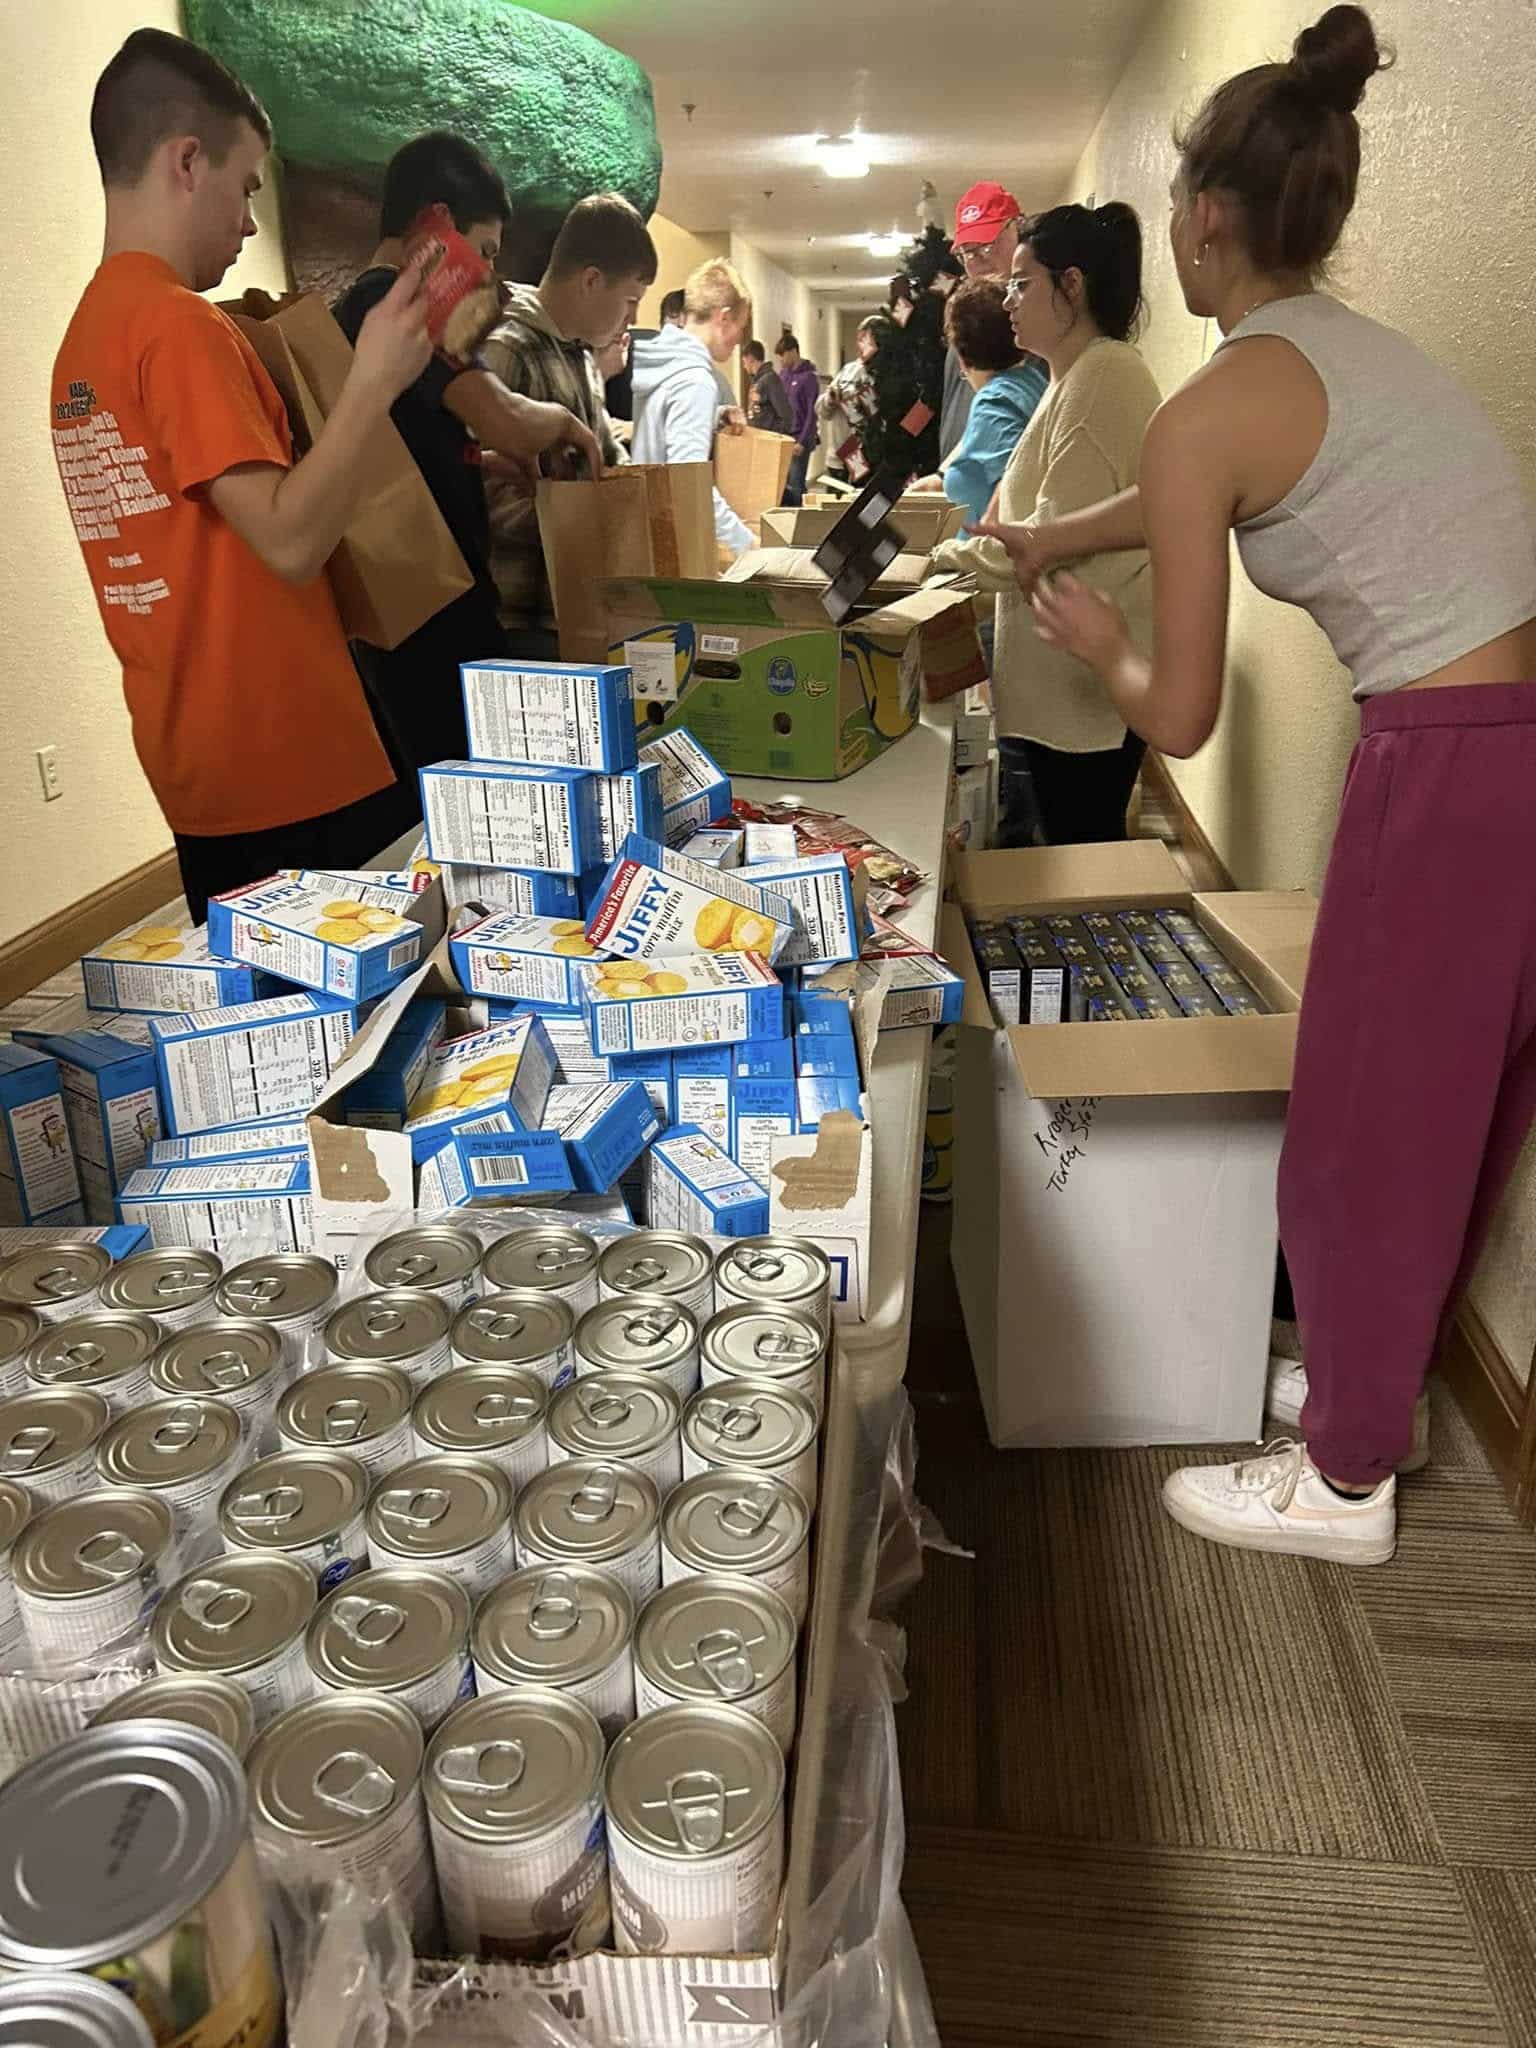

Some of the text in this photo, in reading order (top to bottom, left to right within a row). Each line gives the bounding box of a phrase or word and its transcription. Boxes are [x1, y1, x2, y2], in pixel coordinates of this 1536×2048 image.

[559, 785, 569, 822] Nutrition
[533, 823, 542, 843] 330
[240, 883, 307, 910] JIFFY
[590, 862, 637, 946] America's Favorite
[614, 876, 671, 955] JIFFY
[801, 877, 821, 960] Calories 330 360
[833, 873, 847, 935] Nutrition Facts
[472, 912, 528, 942] JIFFY
[641, 888, 684, 959] corn muffin
[664, 917, 685, 944] mix
[711, 953, 751, 985] JIFFY
[307, 1019, 316, 1052] Calories
[312, 1059, 322, 1078] 330
[435, 1024, 523, 1061] JIFFY
[1034, 1097, 1074, 1157] Kroger
